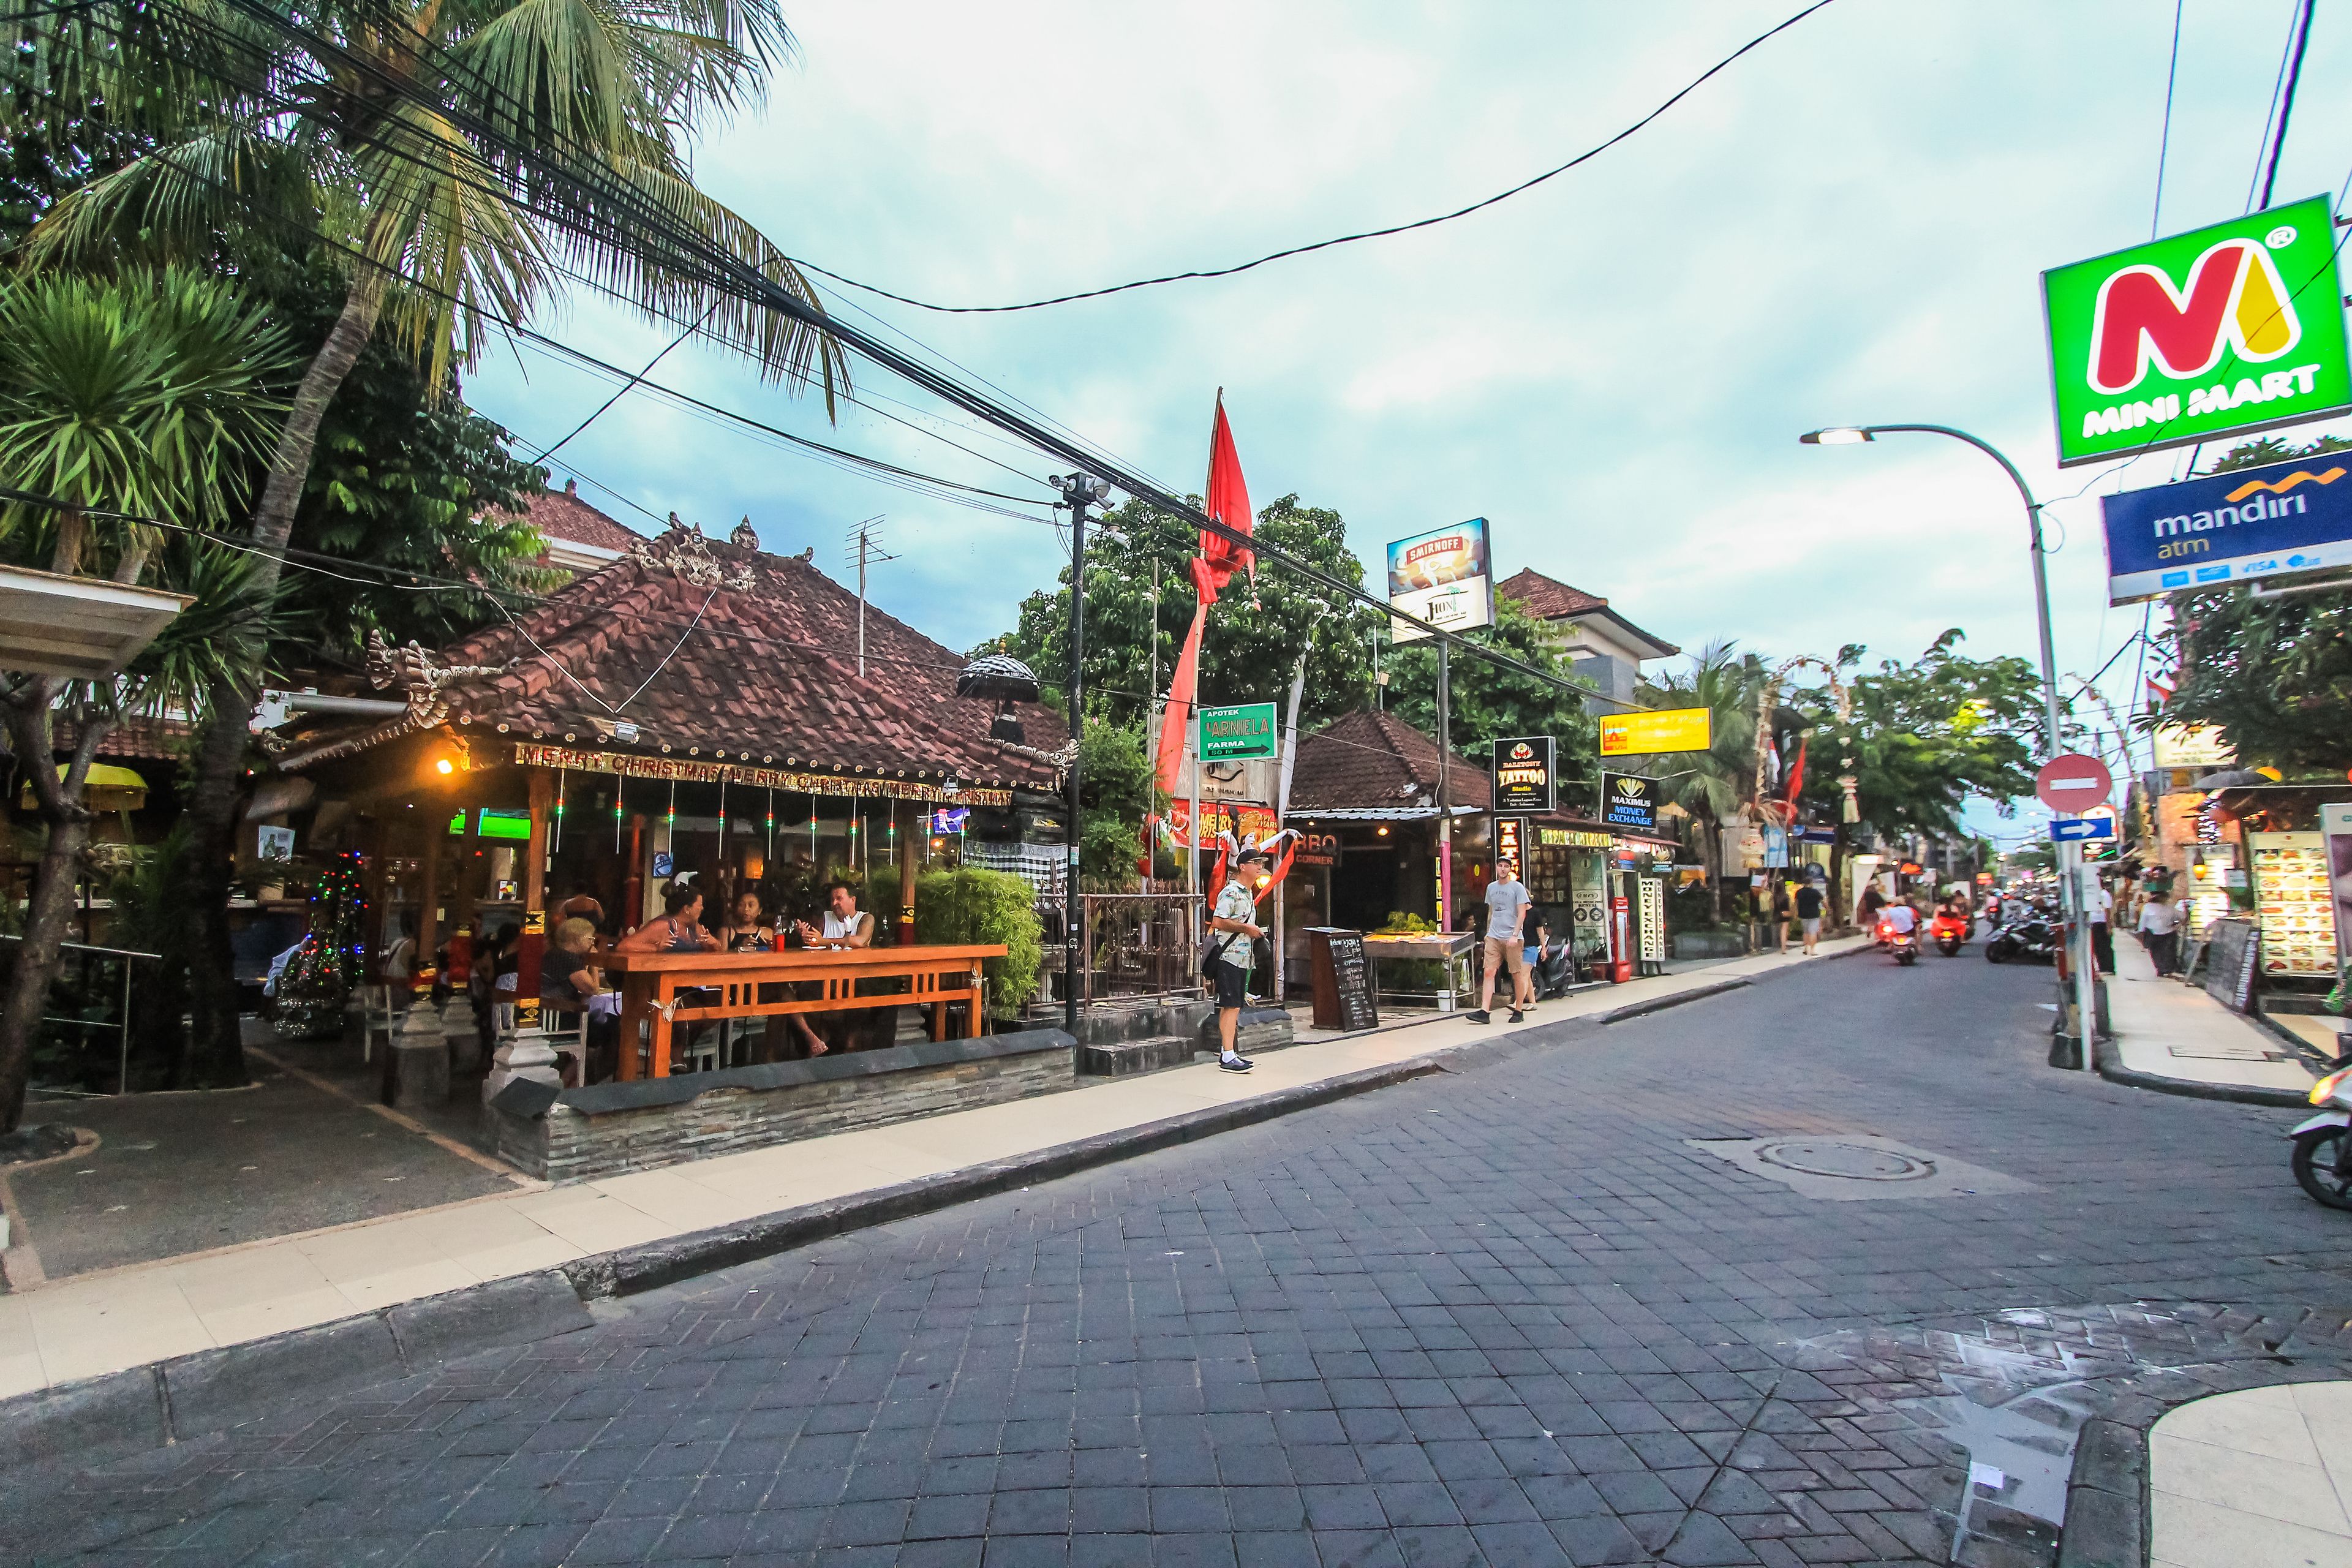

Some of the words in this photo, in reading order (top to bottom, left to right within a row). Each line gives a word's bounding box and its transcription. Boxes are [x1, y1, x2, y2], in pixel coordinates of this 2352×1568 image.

[2082, 394, 2180, 438] MINI
[2187, 363, 2321, 417] MART
[2154, 494, 2307, 538] mandiri
[2158, 538, 2211, 559] atm
[1498, 769, 1546, 788] TATTOO
[1611, 796, 1651, 807] MAXIMUS
[1615, 805, 1646, 816] MONEY
[1608, 813, 1652, 825] EXCHANGE
[1294, 834, 1337, 856] BBQ
[1297, 855, 1333, 865] CORNER
[1642, 881, 1653, 909] MONEY
[1644, 912, 1654, 957] EXCHANGE
